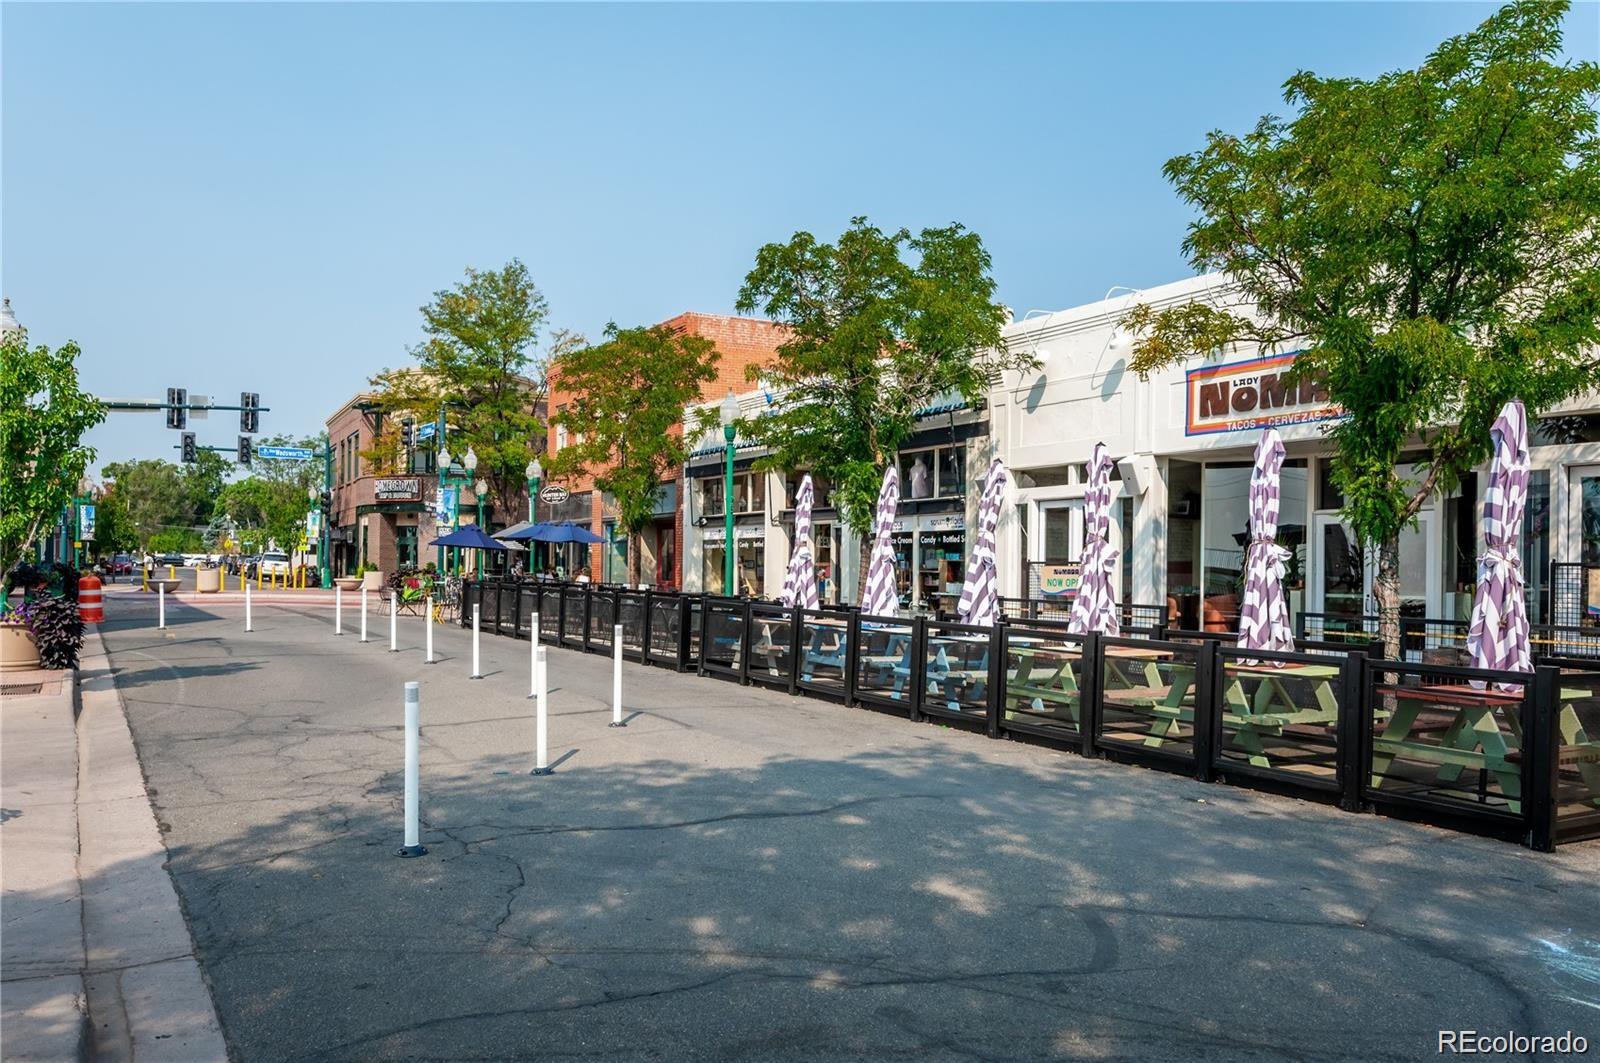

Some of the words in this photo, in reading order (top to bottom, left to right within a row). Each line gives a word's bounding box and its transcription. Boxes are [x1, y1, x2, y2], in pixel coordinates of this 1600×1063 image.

[1233, 376, 1260, 387] LADY
[1226, 421, 1257, 432] TACOS
[1268, 411, 1321, 428] CERVEZAS
[897, 536, 912, 544] Cream
[920, 536, 936, 545] Candy
[942, 534, 960, 543] Bottled
[1046, 577, 1063, 587] NOW
